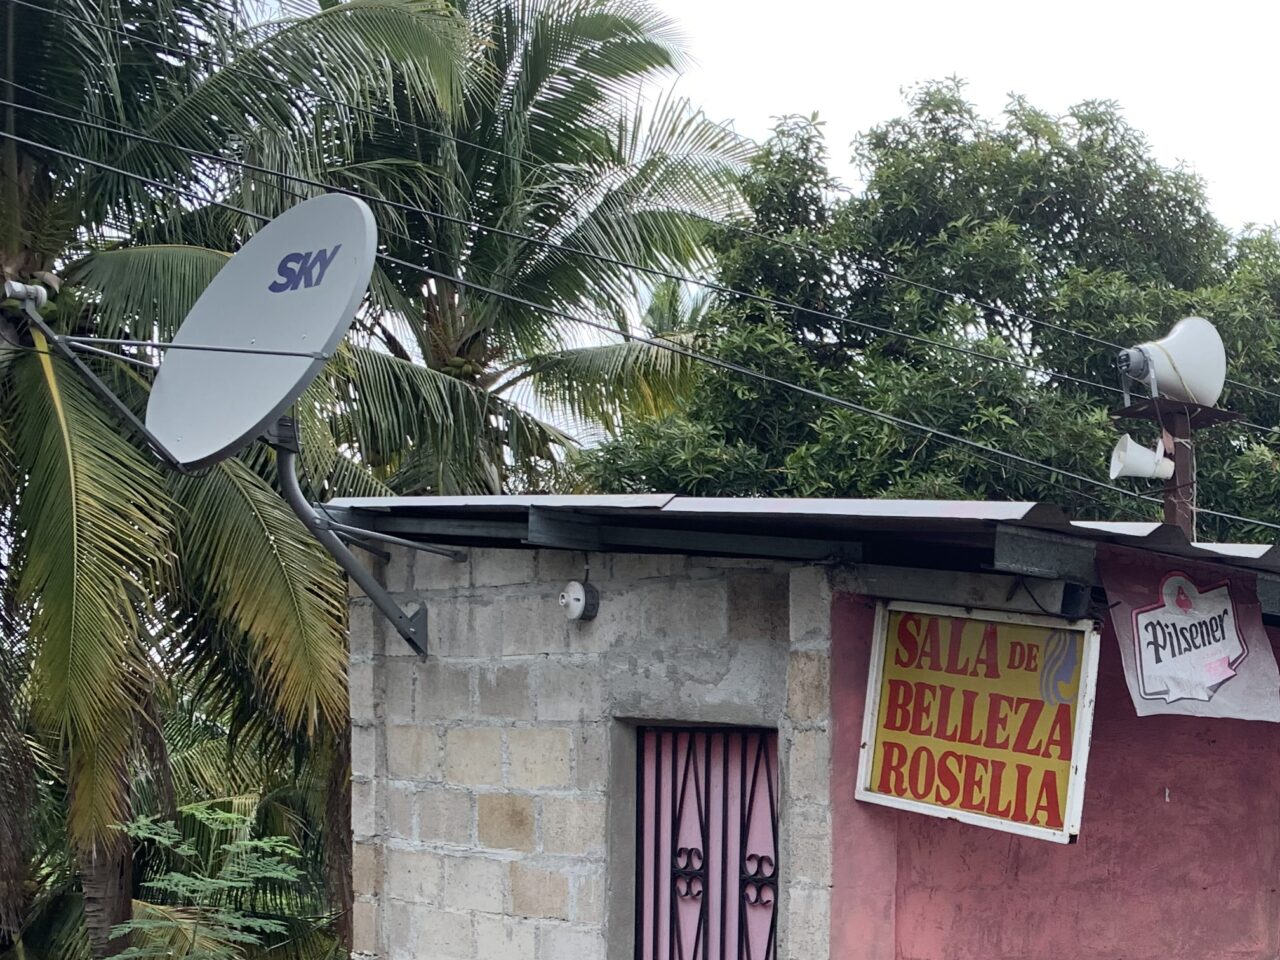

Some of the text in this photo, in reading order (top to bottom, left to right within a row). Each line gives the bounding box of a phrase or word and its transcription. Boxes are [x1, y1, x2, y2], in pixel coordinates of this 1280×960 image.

[268, 244, 342, 293] SKY
[894, 612, 1040, 679] SALA DE
[1144, 608, 1229, 665] Pilsener
[883, 679, 1072, 762] BELLEZA
[877, 741, 1064, 829] ROSELIA
